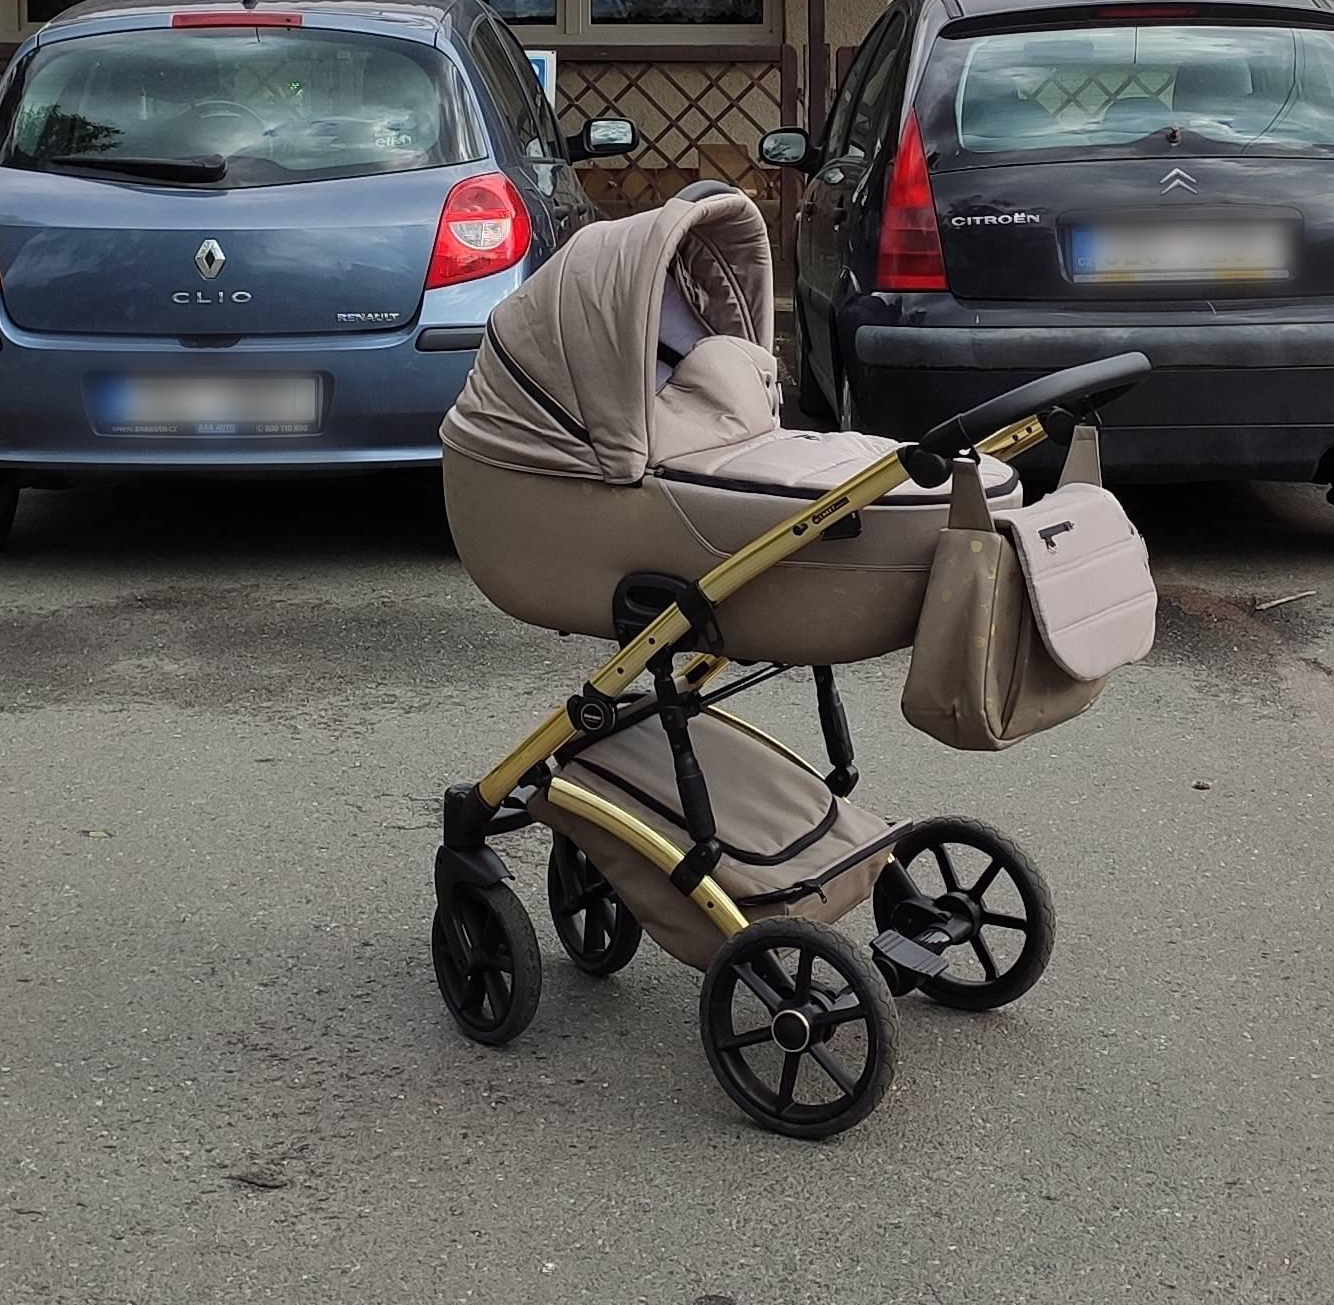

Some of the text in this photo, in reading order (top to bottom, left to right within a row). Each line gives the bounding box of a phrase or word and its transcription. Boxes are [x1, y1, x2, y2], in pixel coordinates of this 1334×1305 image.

[951, 212, 1040, 226] CITROËN
[171, 291, 252, 304] CLIO
[336, 312, 400, 323] RENAULT
